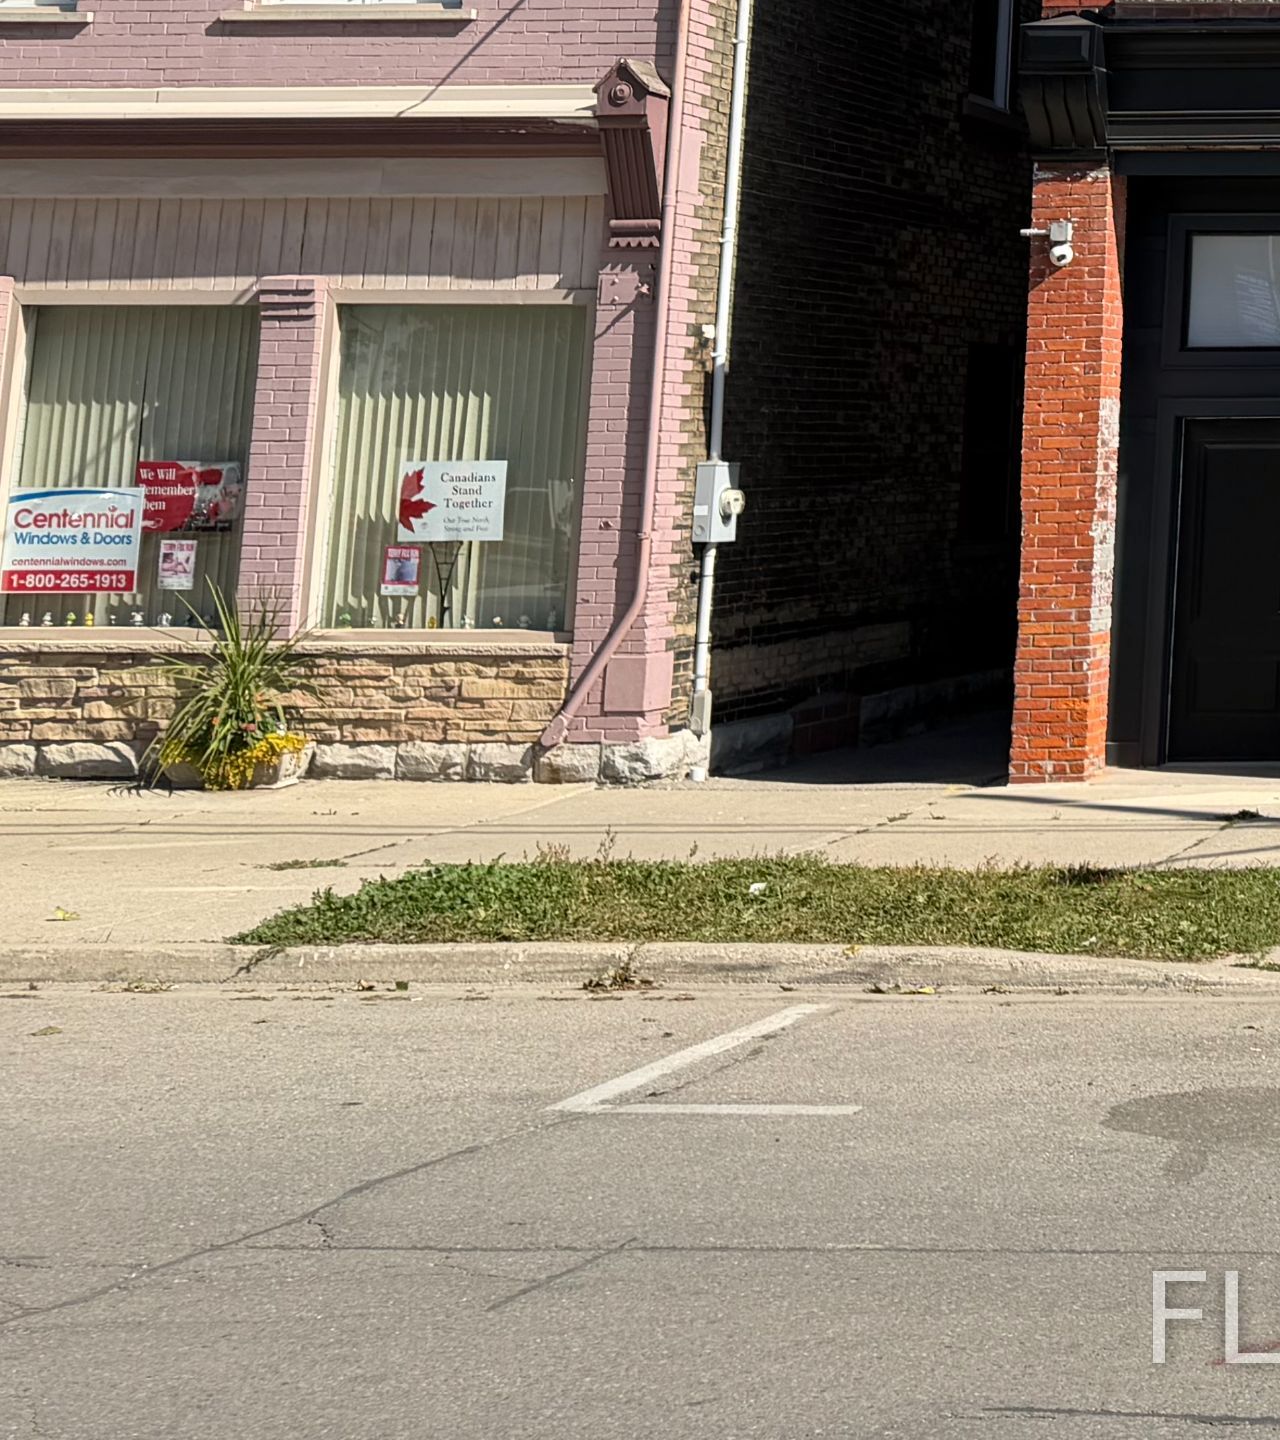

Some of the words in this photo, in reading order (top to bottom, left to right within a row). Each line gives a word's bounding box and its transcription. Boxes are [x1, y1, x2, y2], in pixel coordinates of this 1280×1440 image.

[139, 468, 156, 481] We
[157, 468, 176, 481] Will
[440, 472, 496, 483] Canadians
[451, 485, 482, 496] Stand
[143, 499, 166, 511] hem
[443, 498, 494, 510] Together
[14, 507, 134, 530] Centennial
[14, 531, 78, 546] Windows
[80, 532, 91, 545] &
[96, 532, 133, 546] Doors
[11, 556, 127, 567] centennialwindows.com
[11, 573, 127, 588] 1-800-265-1913
